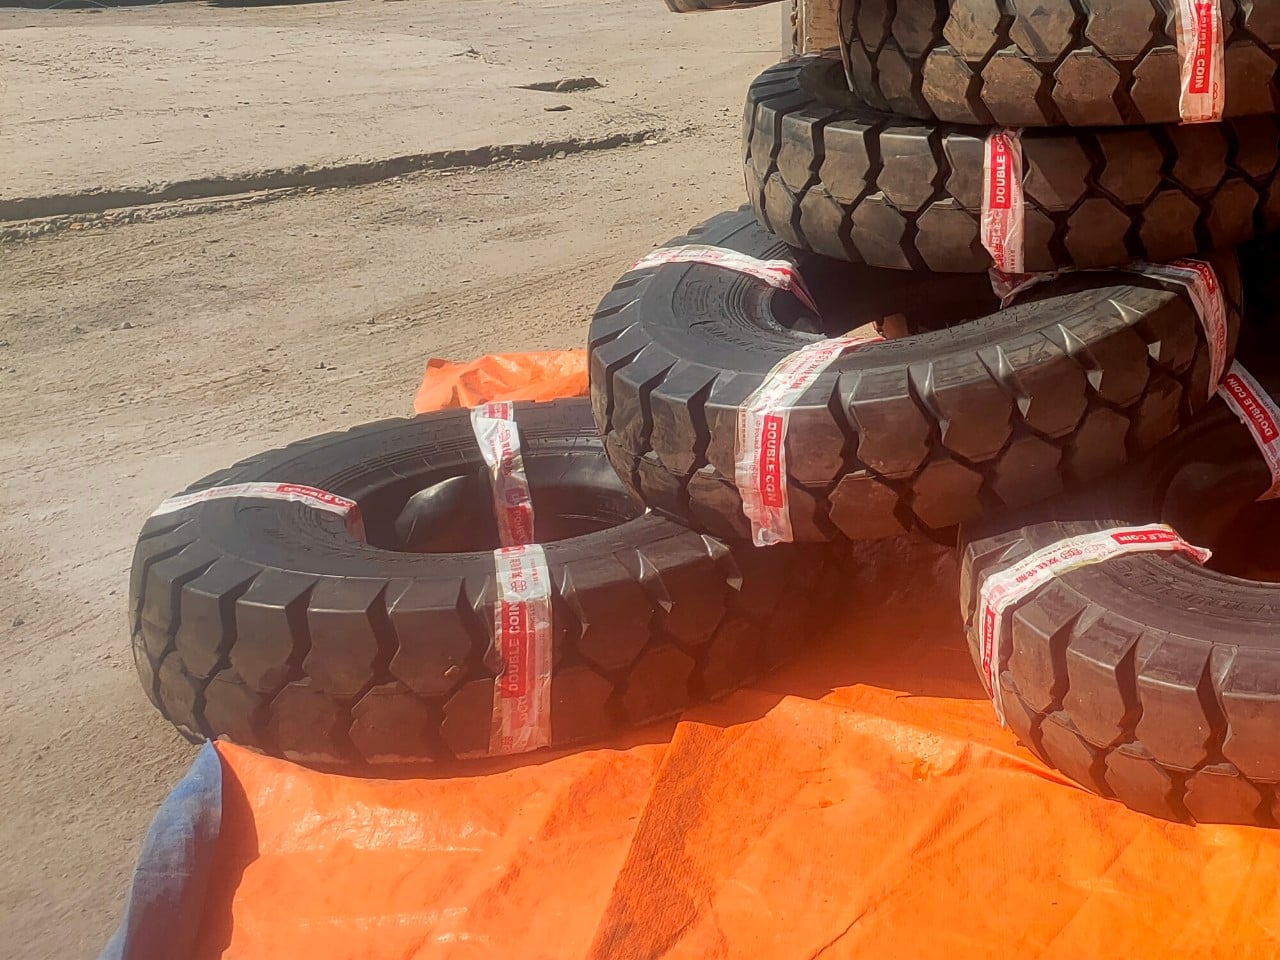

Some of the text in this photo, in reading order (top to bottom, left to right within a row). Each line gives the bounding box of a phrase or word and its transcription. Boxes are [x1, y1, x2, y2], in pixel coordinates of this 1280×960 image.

[1194, 57, 1206, 89] COIN
[996, 155, 1006, 204] DOUBLE
[1228, 377, 1247, 398] COIN
[1242, 396, 1274, 438] DOUBLE
[765, 422, 777, 473] DOUBLE
[1118, 532, 1142, 543] COIN
[508, 601, 520, 691] DOUBLE COIN
